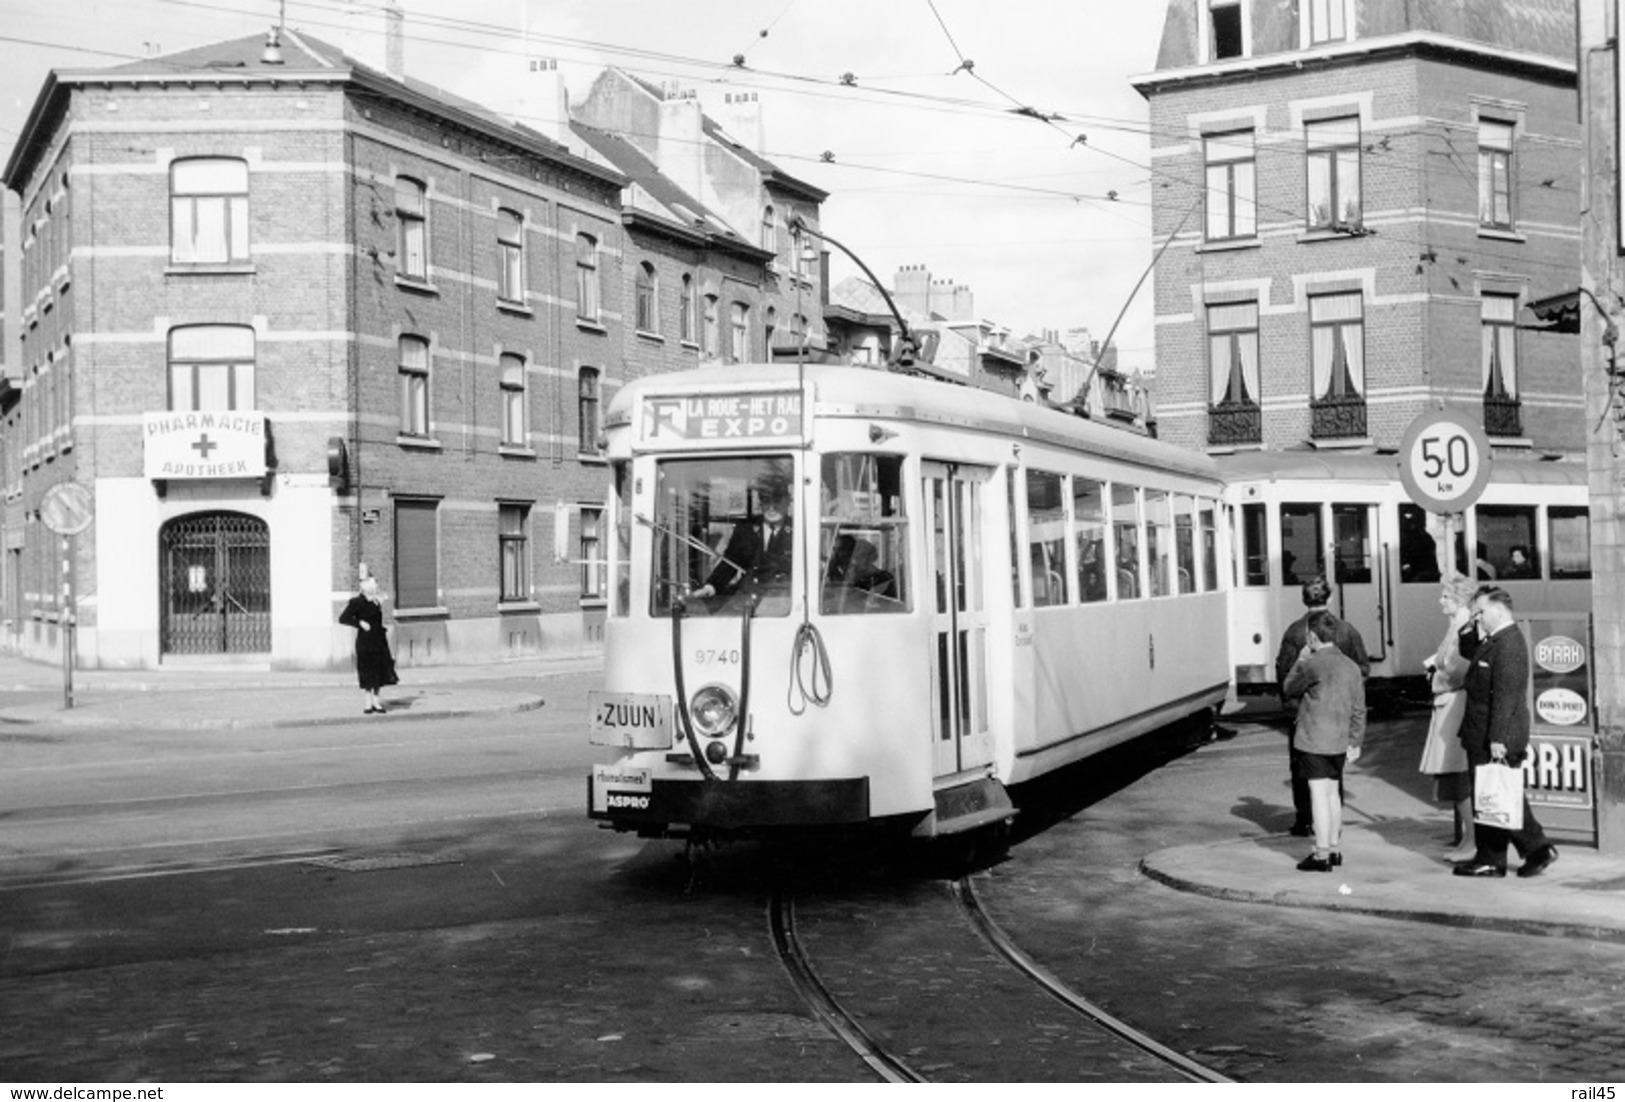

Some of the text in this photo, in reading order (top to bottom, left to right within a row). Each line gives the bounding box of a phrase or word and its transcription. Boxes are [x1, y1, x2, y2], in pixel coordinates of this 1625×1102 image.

[687, 398, 704, 417] LA
[147, 413, 261, 436] PHARMACIE
[650, 402, 681, 437] F
[701, 416, 788, 438] EXPO
[1421, 435, 1470, 479] 50
[162, 460, 248, 476] APOTHEEK
[1437, 481, 1453, 493] km
[695, 649, 740, 665] 9740
[1539, 645, 1579, 664] BYRRH
[603, 702, 656, 728] ZUUN
